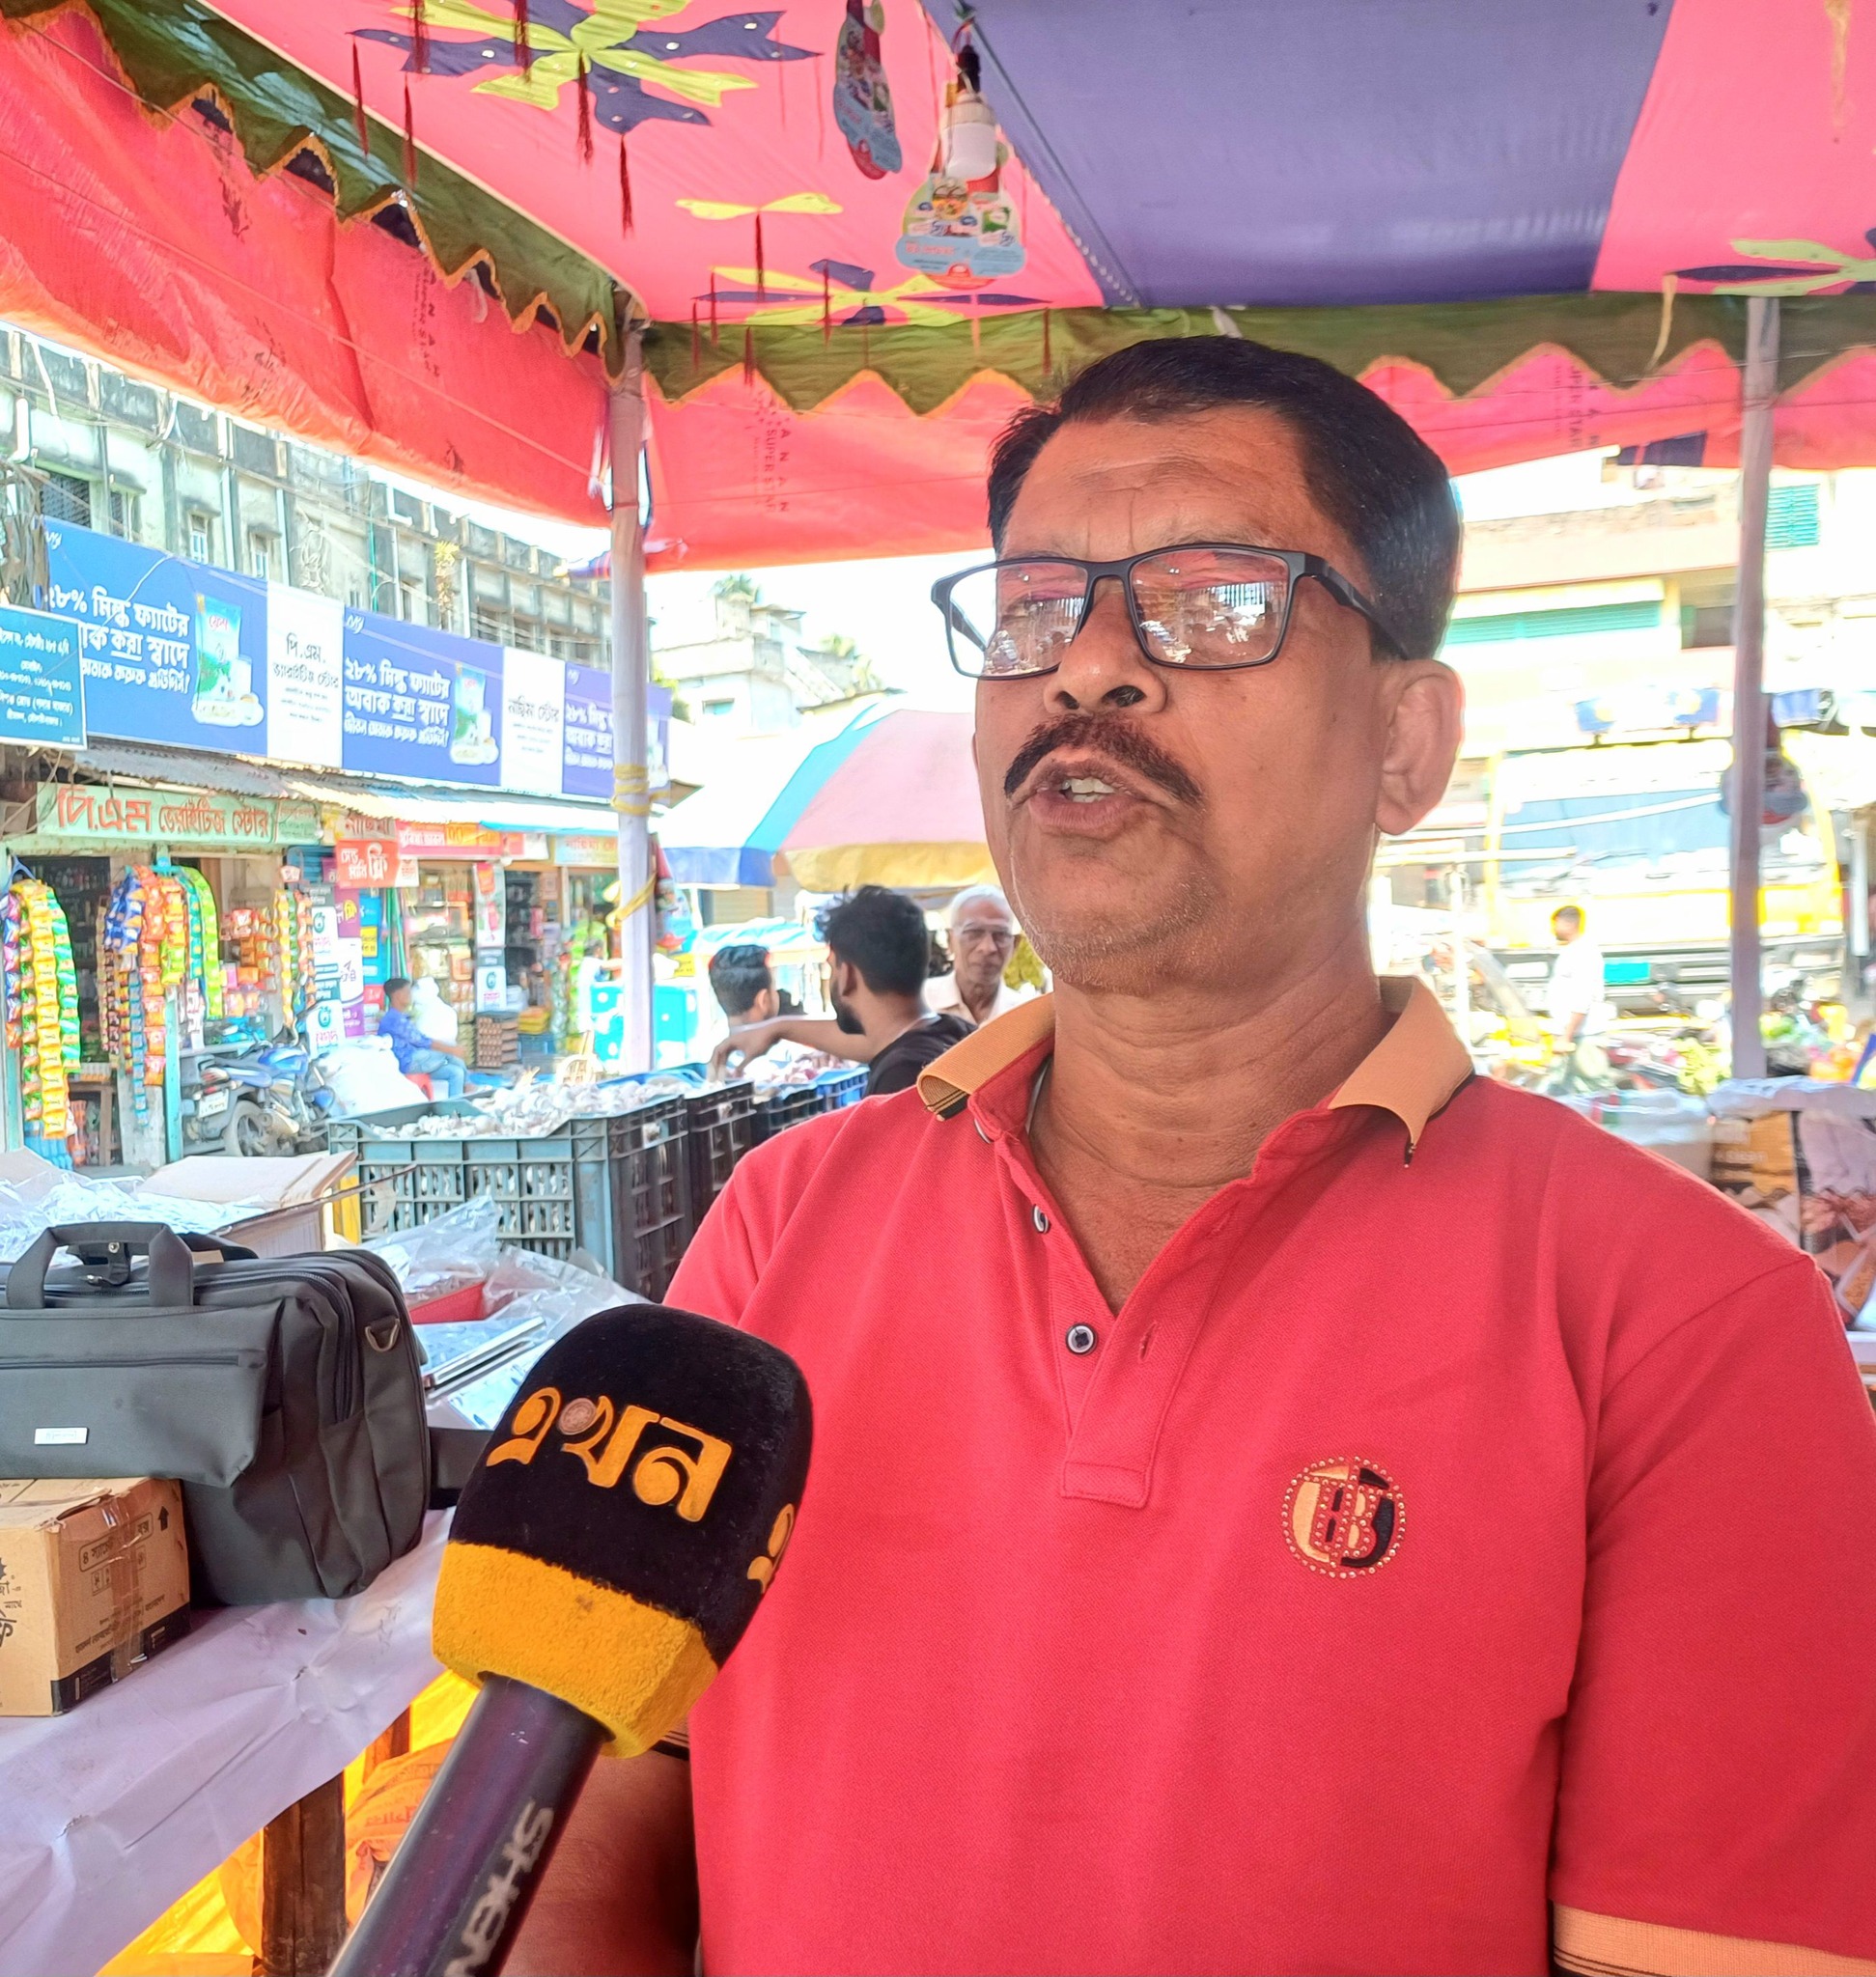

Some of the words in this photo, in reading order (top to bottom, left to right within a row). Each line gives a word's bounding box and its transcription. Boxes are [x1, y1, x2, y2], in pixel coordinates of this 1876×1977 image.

[92, 585, 131, 628] মিল্ক
[132, 601, 190, 638] ফ্যাটের
[110, 628, 144, 656] করা
[146, 635, 190, 669] স্বাদে
[344, 656, 378, 683] ২৮%
[379, 657, 408, 694] মিল্ক
[409, 669, 451, 700] ফ্যাটের
[345, 685, 392, 714] অবাক
[392, 694, 417, 719] করা
[417, 699, 451, 727] স্বাদে
[486, 1386, 733, 1523] এখন
